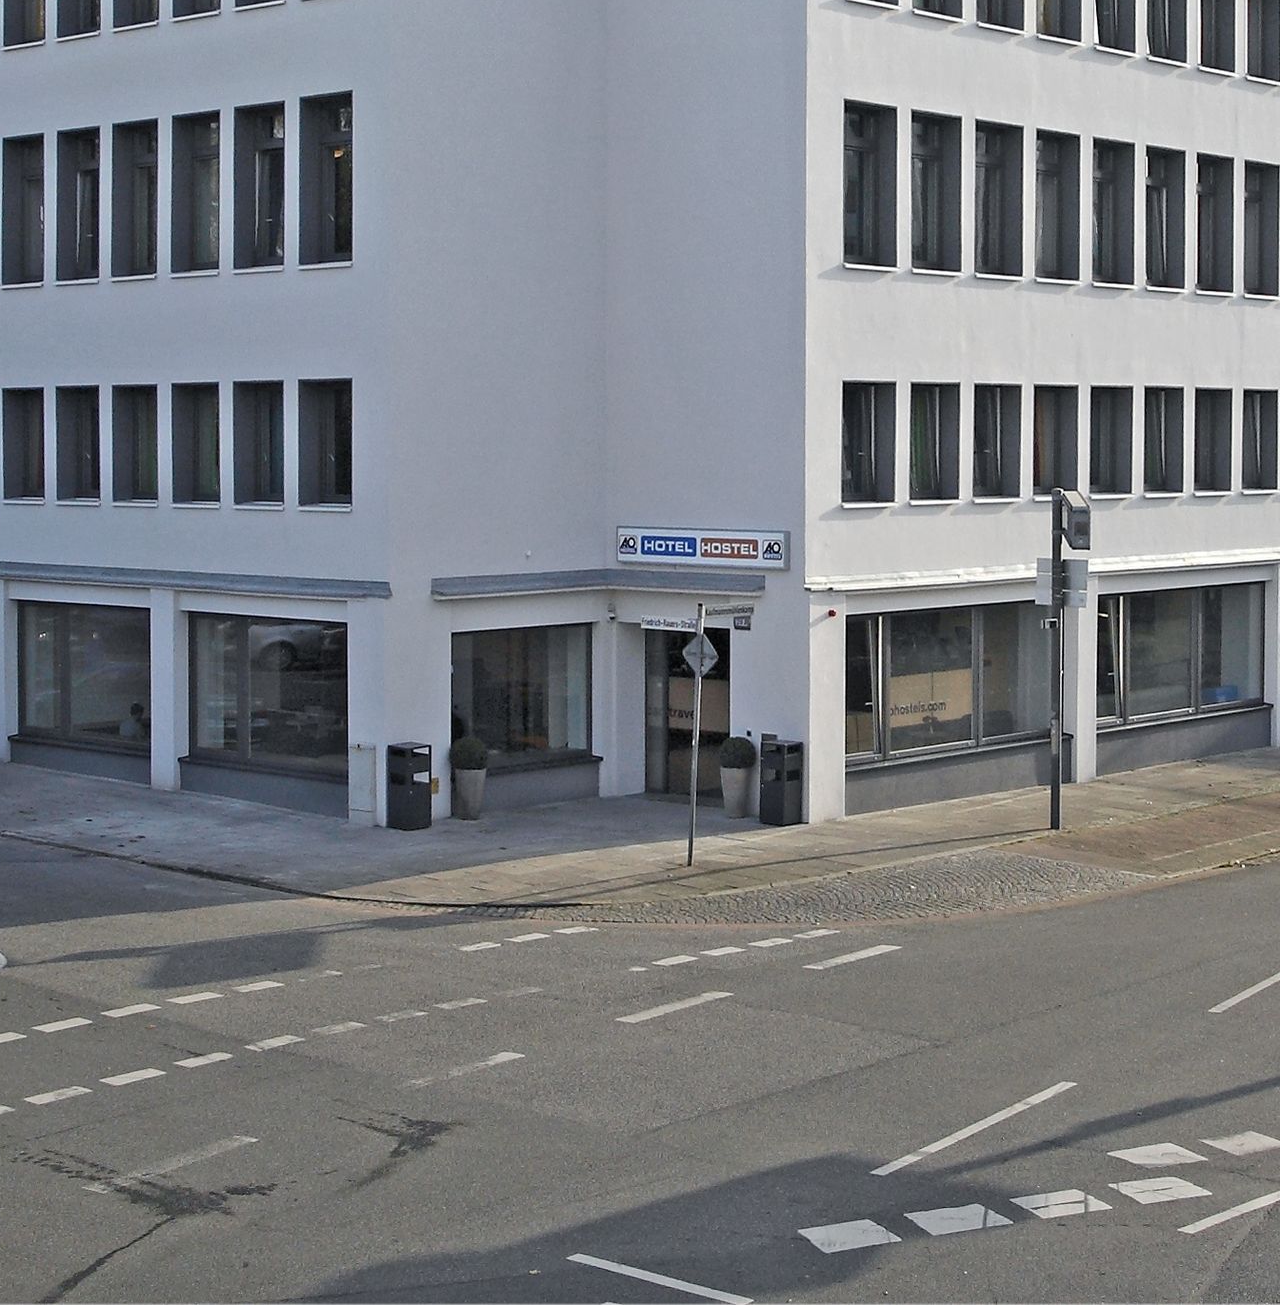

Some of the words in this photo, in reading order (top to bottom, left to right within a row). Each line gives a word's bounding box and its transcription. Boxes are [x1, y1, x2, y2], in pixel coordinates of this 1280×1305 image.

[644, 539, 693, 553] HOTEL
[701, 541, 758, 555] HOSTEL
[669, 708, 695, 720] trave
[890, 701, 946, 716] ohostels.com
